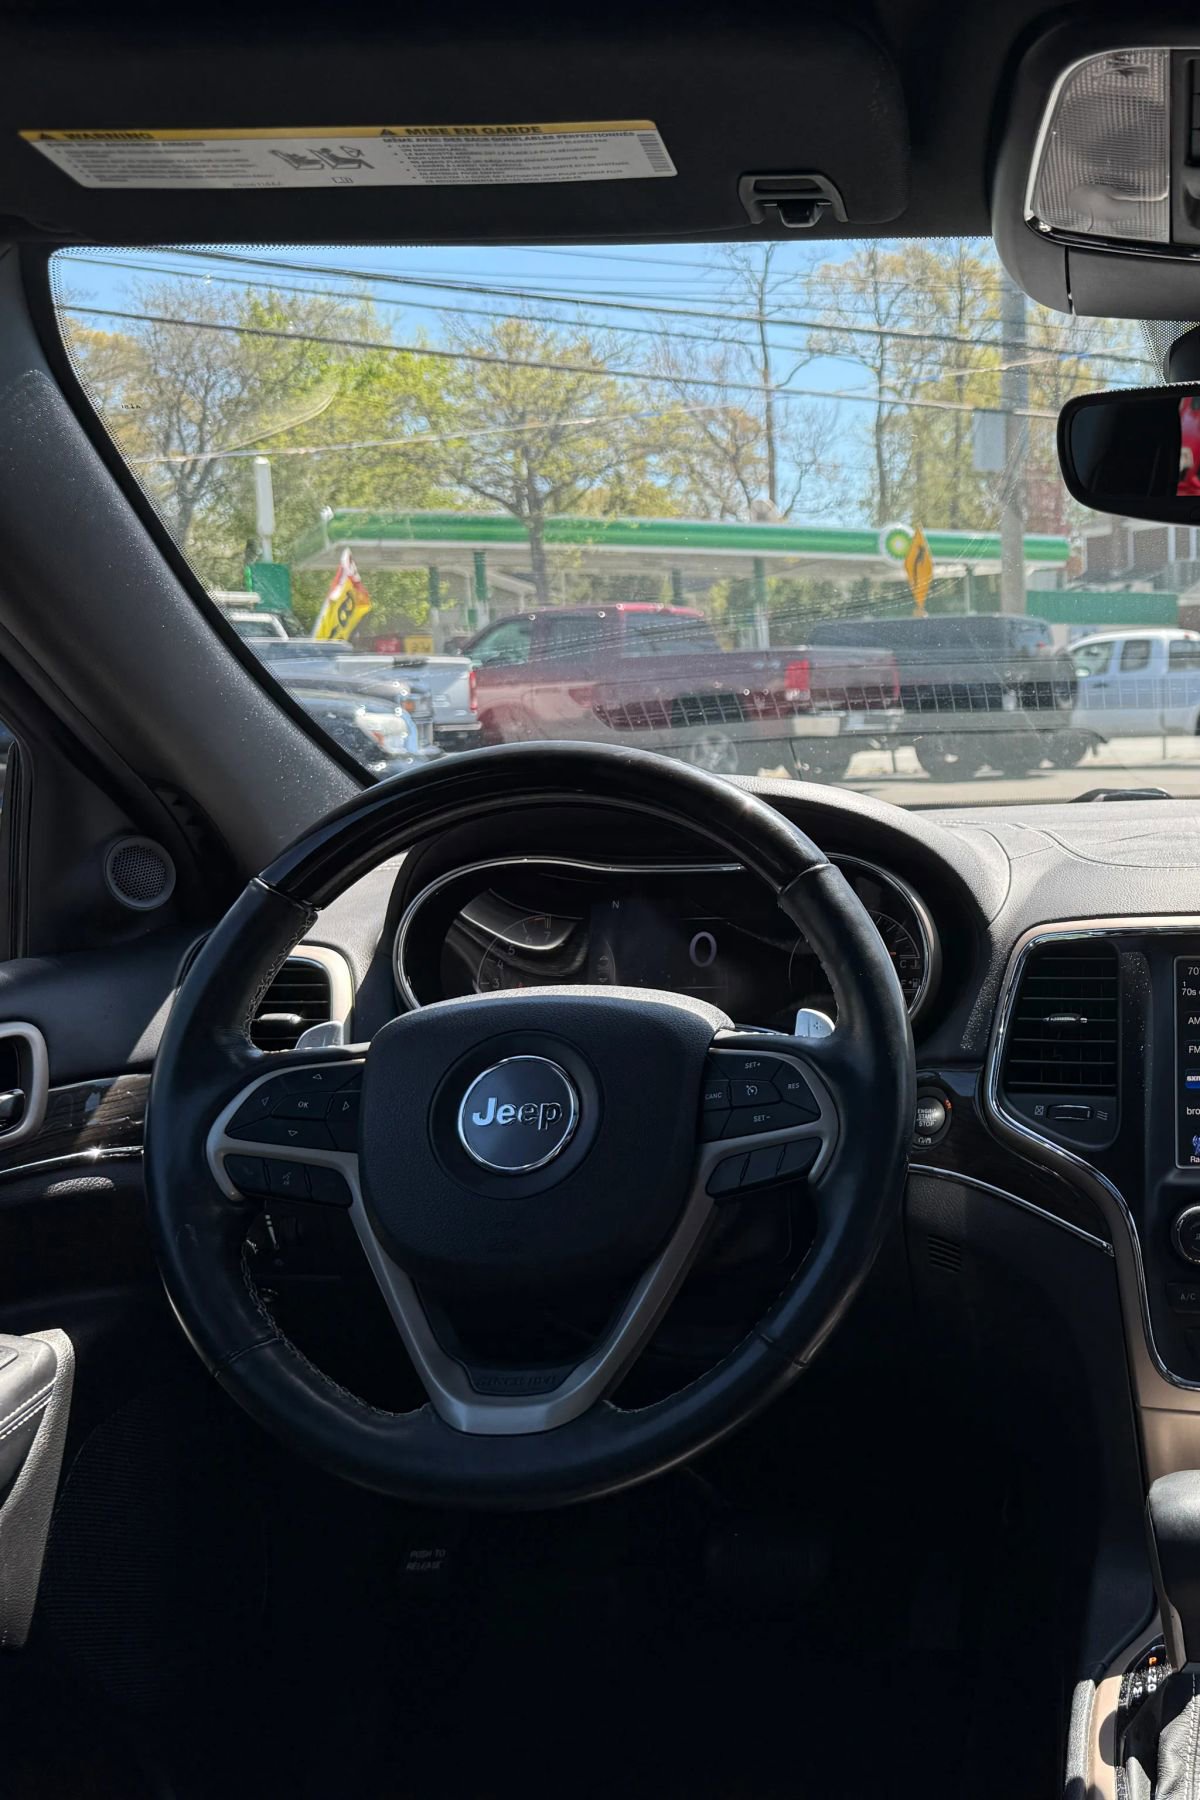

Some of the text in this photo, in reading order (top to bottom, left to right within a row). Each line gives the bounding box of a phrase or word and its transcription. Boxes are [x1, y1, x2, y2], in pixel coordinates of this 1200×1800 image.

[405, 126, 543, 136] MISE EN GARDE
[611, 900, 619, 909] N
[525, 934, 532, 944] 6
[544, 931, 551, 941] 7
[508, 946, 515, 955] 5
[689, 931, 717, 967] 0
[497, 960, 504, 969] 4
[492, 978, 499, 988] 3
[1181, 988, 1197, 996] 70s
[787, 1082, 800, 1090] RES
[297, 1101, 309, 1109] OK
[472, 1097, 563, 1130] Jeep
[1180, 1293, 1196, 1301] A/C
[1149, 1656, 1158, 1665] P
[1147, 1683, 1157, 1692] D
